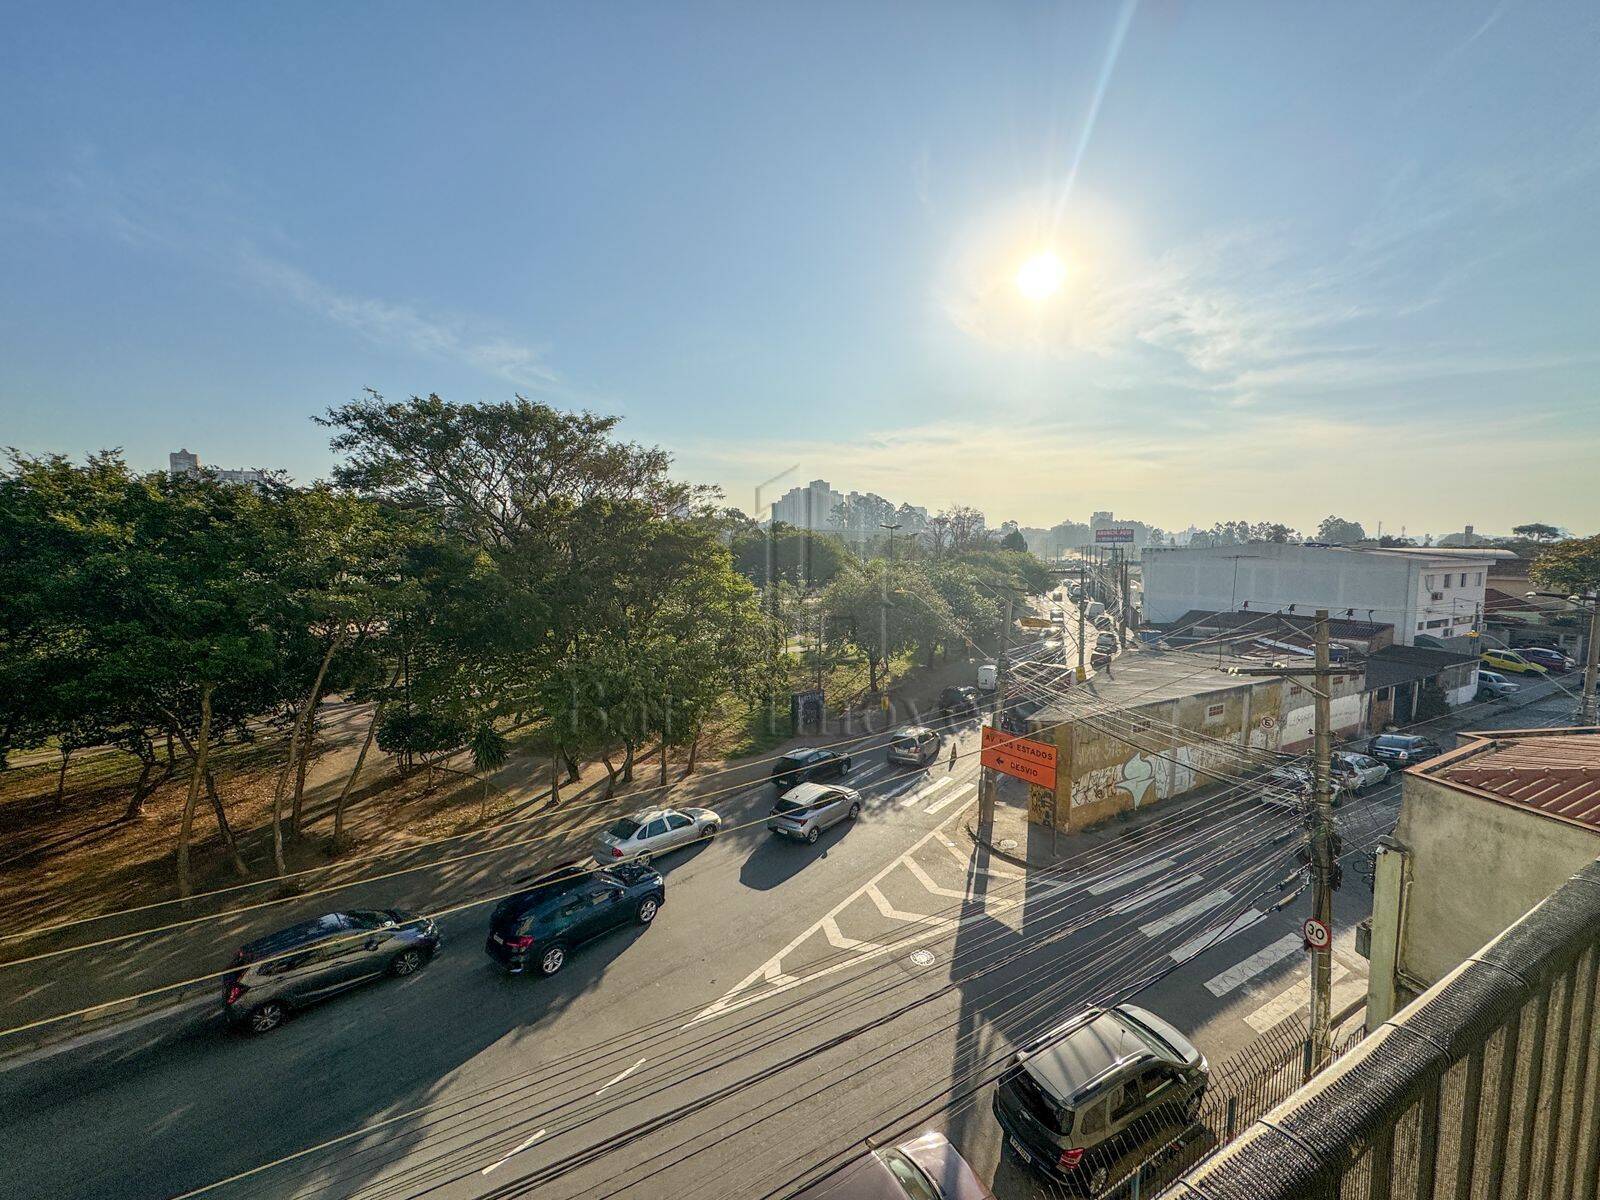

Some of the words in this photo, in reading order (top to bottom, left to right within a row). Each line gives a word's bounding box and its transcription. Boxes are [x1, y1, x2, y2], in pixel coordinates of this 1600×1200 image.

[1016, 744, 1053, 761] ESTADOS
[1010, 762, 1038, 777] DESVIO
[1308, 923, 1325, 940] 30
